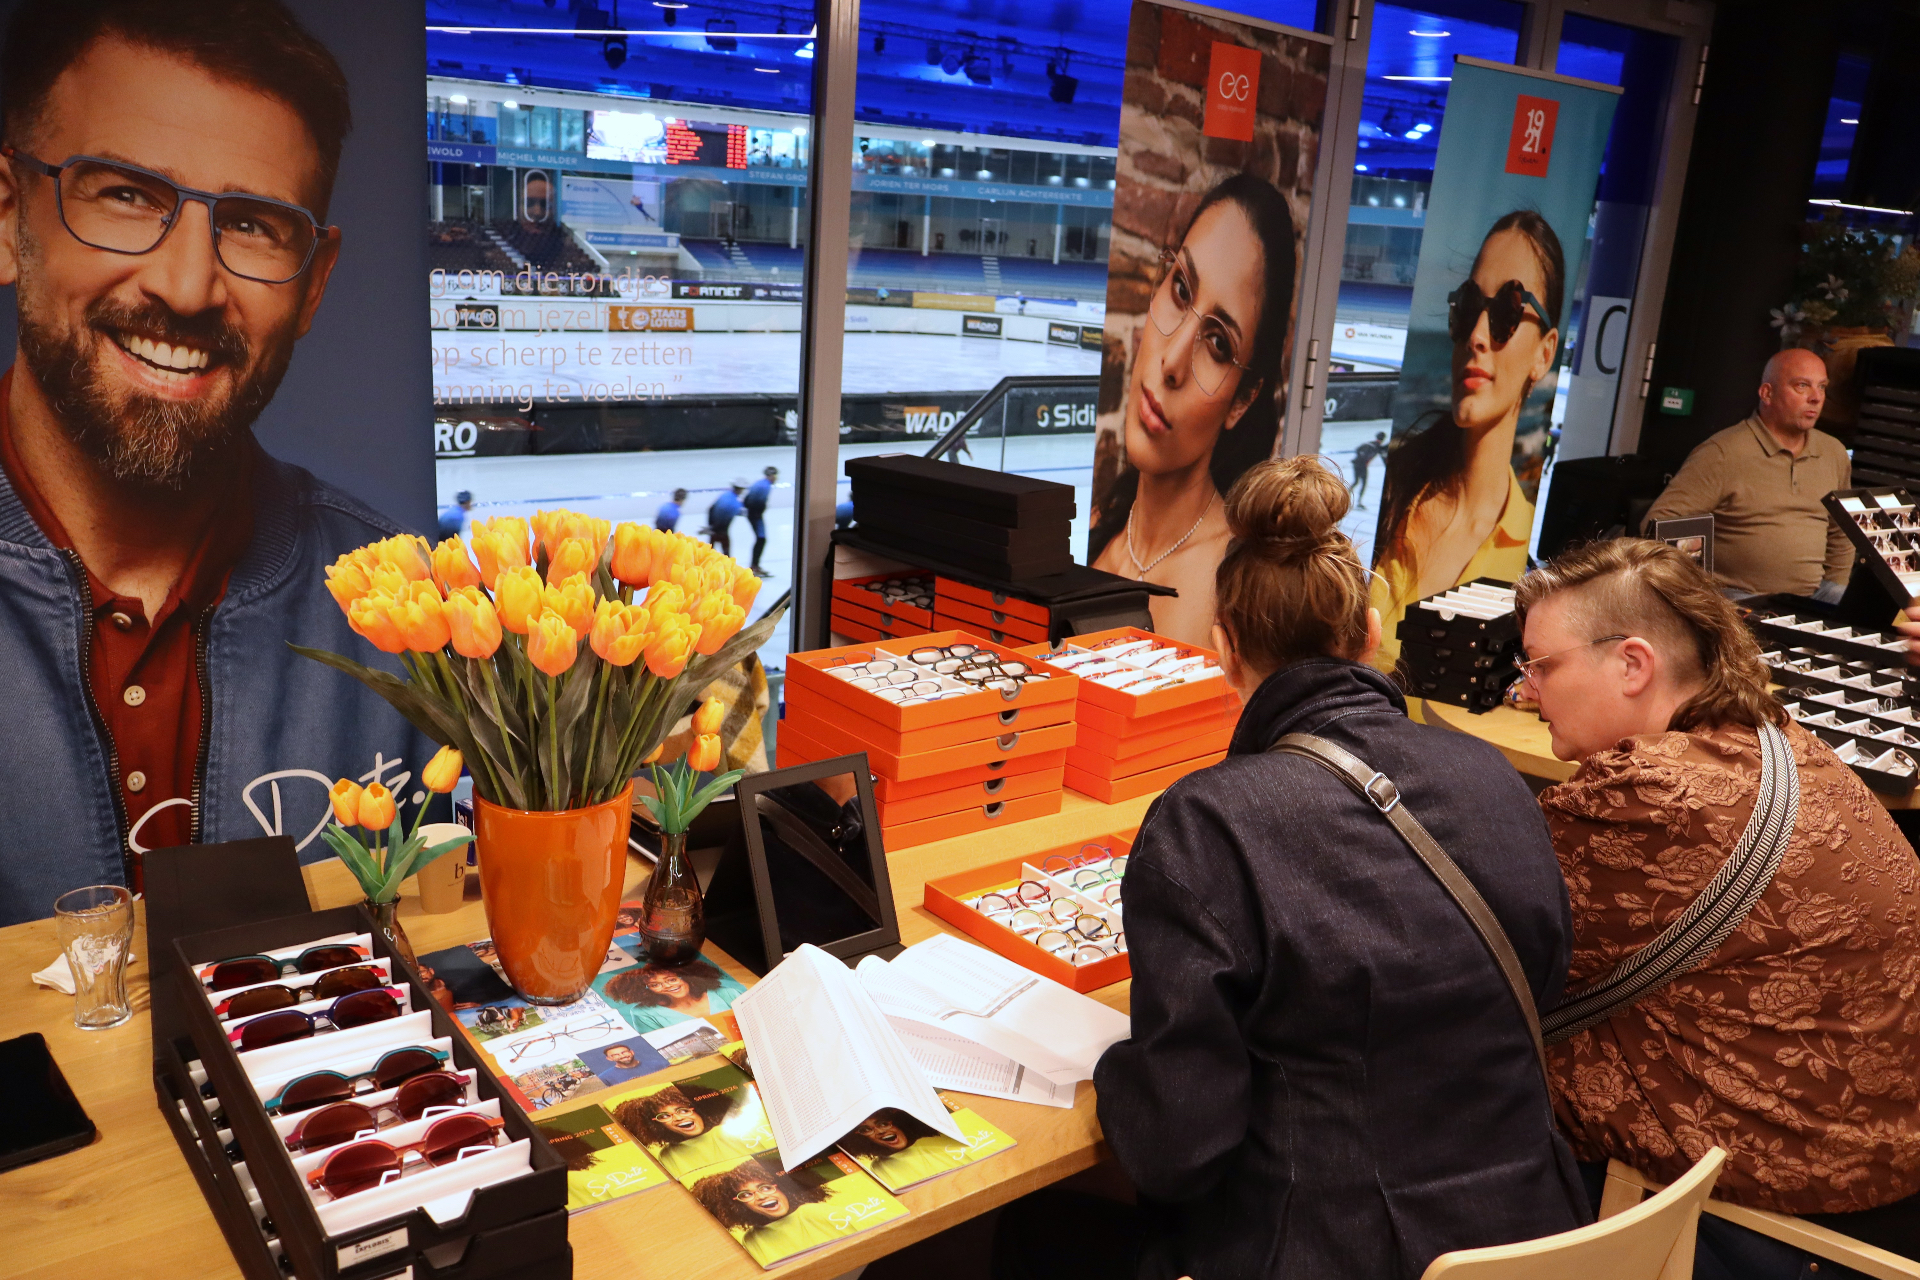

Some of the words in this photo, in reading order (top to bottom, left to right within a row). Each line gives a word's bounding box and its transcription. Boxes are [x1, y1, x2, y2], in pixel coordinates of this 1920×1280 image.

[497, 151, 535, 162] MICHEL
[537, 153, 578, 165] MULDER
[748, 170, 784, 180] STEFAN
[869, 179, 901, 189] JORIEN
[904, 181, 920, 190] TER
[922, 182, 950, 192] MORS
[458, 268, 505, 290] om
[516, 262, 559, 292] die
[567, 266, 670, 301] rondjes
[679, 286, 742, 298] FORTINET
[480, 308, 526, 329] om
[534, 303, 612, 337] jezelf
[621, 305, 645, 330] te
[650, 309, 687, 319] STAATS
[966, 320, 999, 333] WADRO
[470, 339, 567, 373] scherp
[576, 341, 602, 366] te
[611, 341, 692, 366] zetten
[543, 378, 571, 404] te
[1053, 404, 1097, 428] Sidi
[693, 1091, 719, 1103] SPRING
[719, 1085, 739, 1096] 2026
[549, 1133, 574, 1145] PRING
[575, 1128, 596, 1139] 2026
[587, 1179, 611, 1198] So
[606, 1165, 648, 1186] Dutz.
[828, 1211, 852, 1230] So
[845, 1196, 885, 1217] Dutz.
